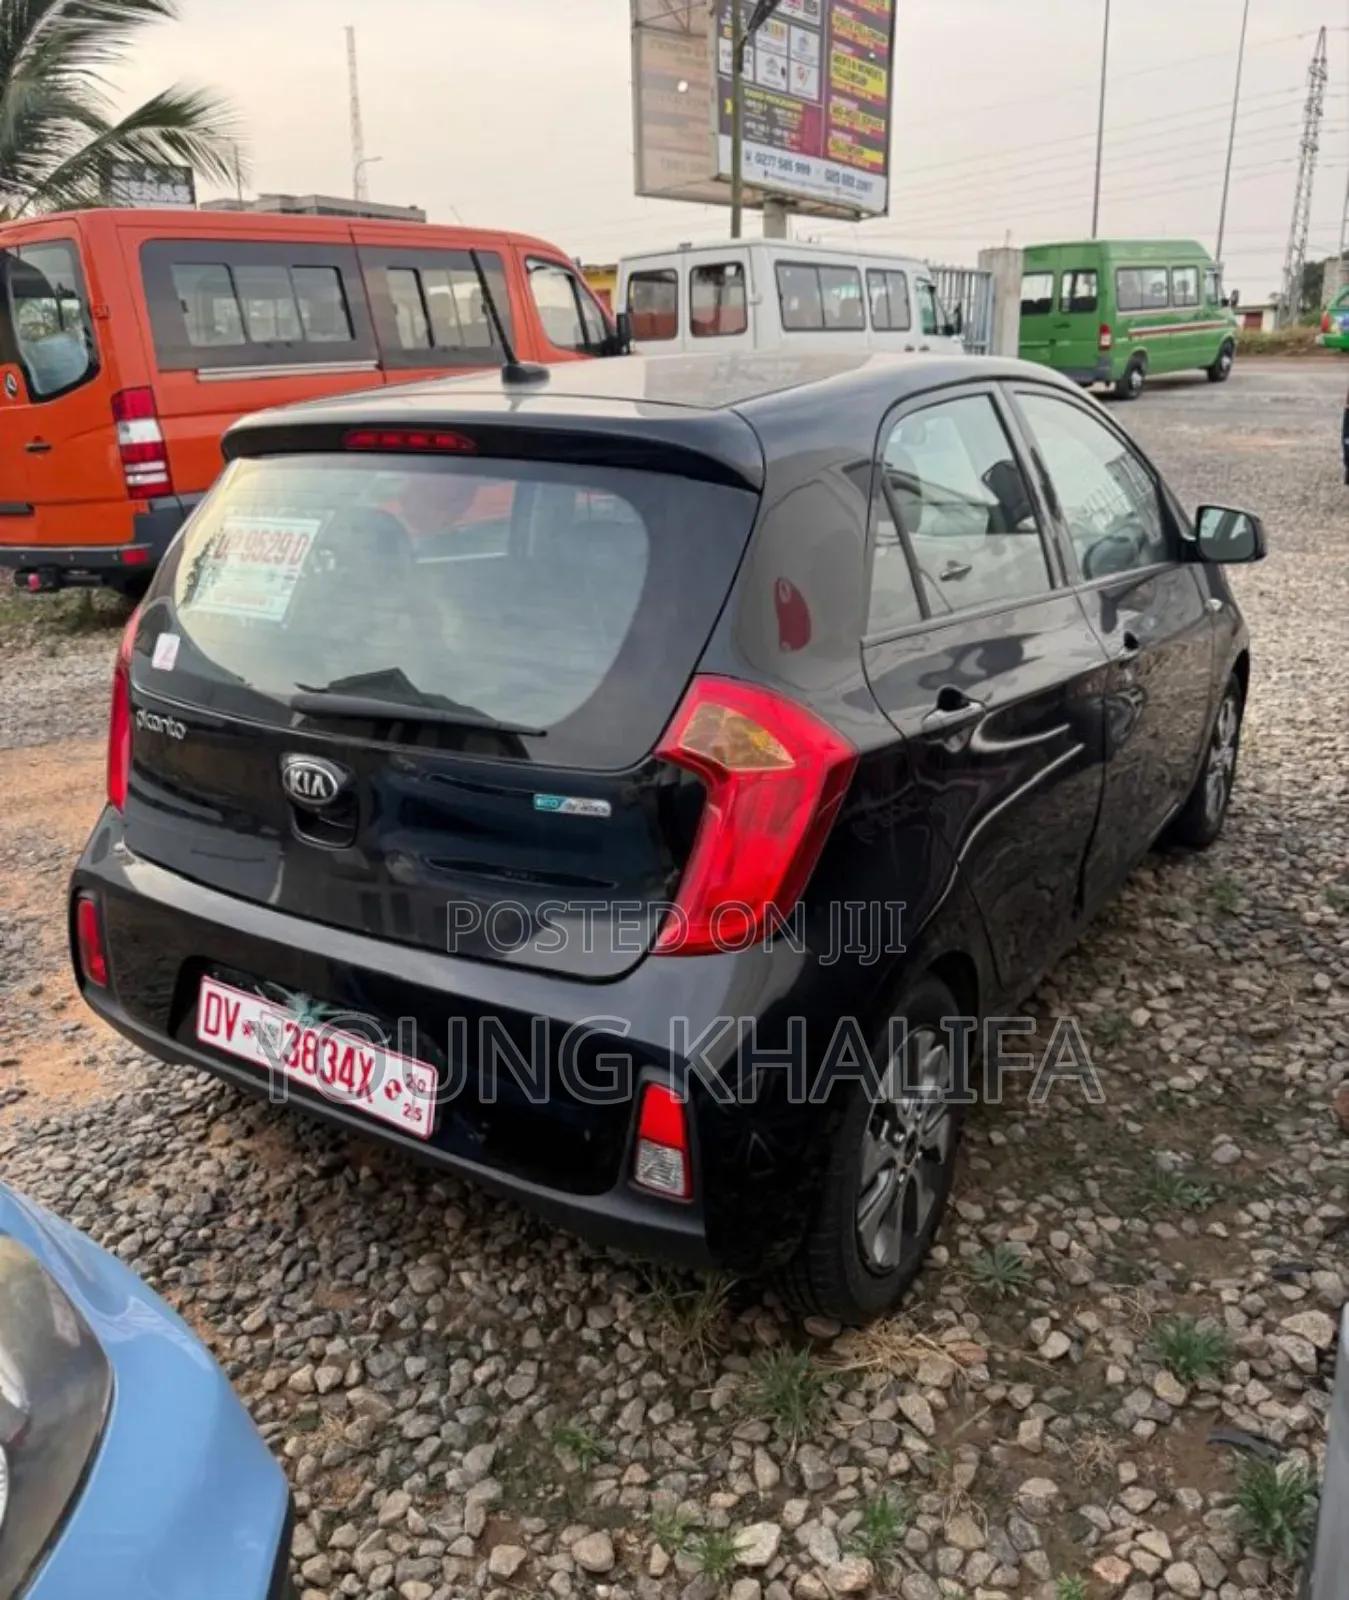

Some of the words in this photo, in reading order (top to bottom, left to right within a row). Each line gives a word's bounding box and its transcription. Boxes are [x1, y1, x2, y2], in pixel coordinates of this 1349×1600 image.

[289, 770, 326, 798] KIA
[203, 991, 241, 1042] DV
[402, 1102, 423, 1123] 25
